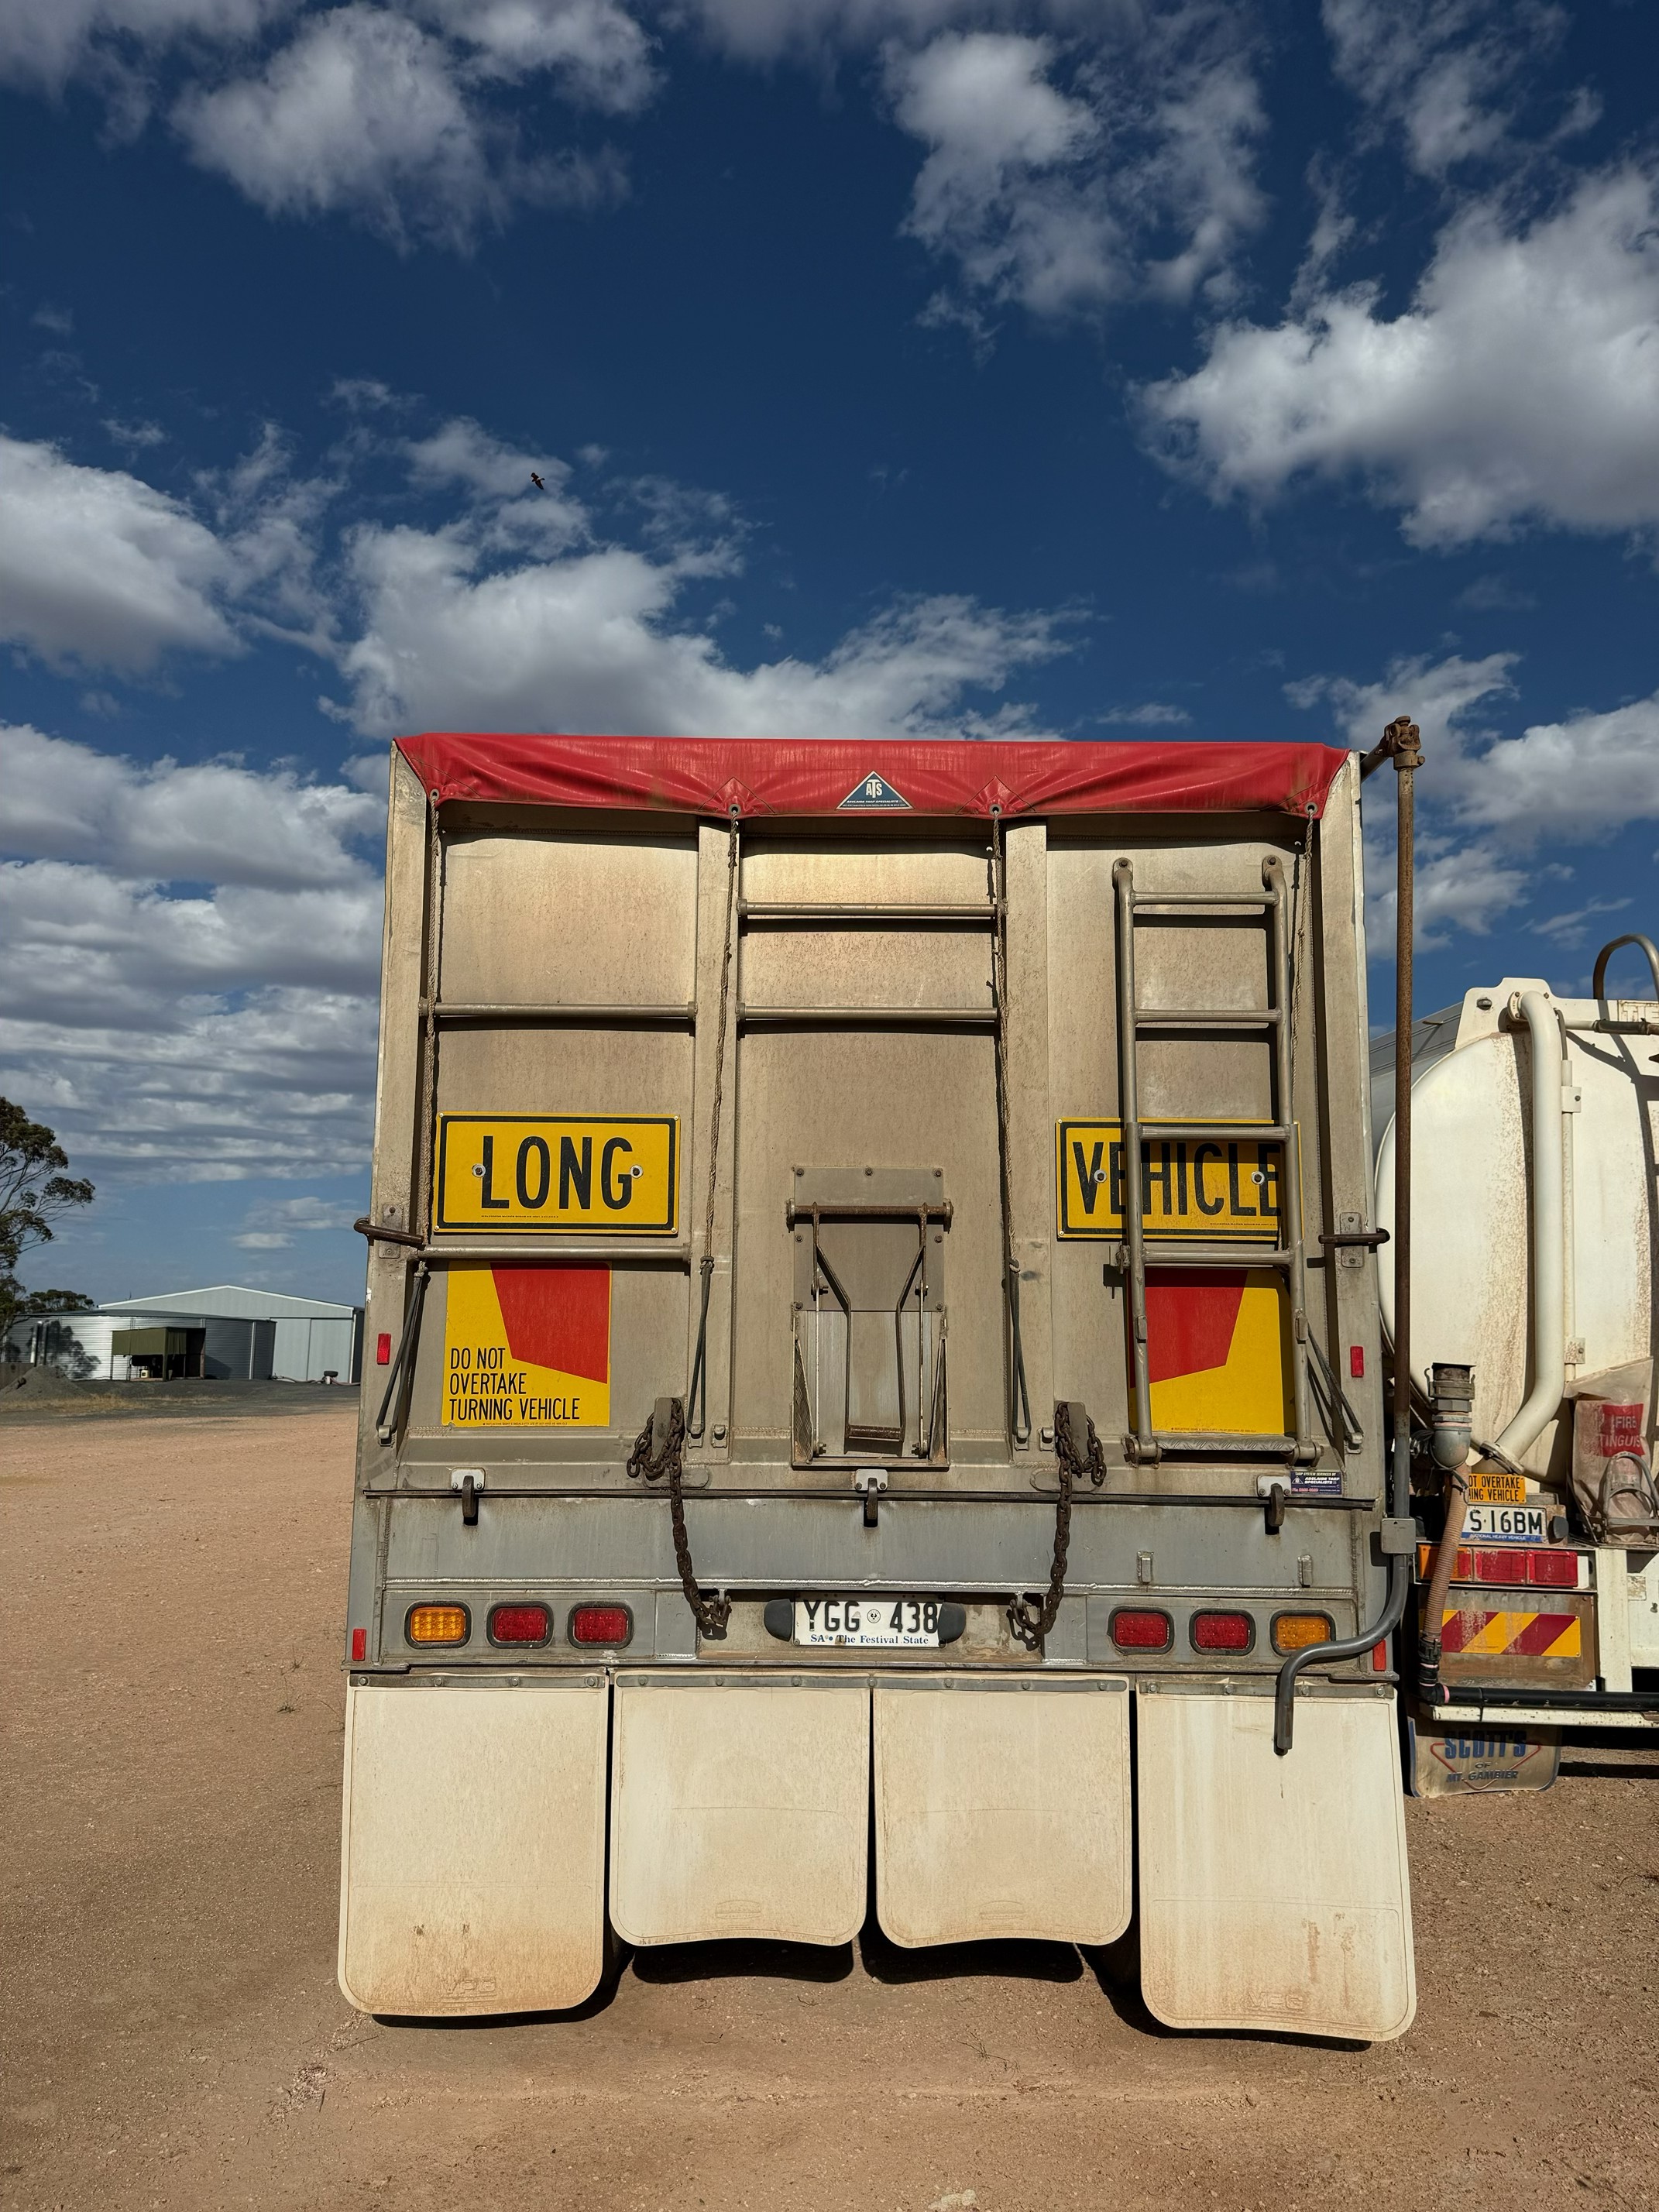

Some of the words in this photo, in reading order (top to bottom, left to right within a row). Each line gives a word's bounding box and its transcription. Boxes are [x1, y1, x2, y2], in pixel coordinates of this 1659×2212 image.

[866, 779, 882, 798] ATS
[481, 1135, 633, 1210] LONG
[1073, 1141, 1282, 1217] VEHICLE
[450, 1348, 471, 1369] DO
[476, 1347, 506, 1369] NOT
[449, 1372, 527, 1395] OVERTAKE
[449, 1397, 513, 1420] TURNING
[519, 1397, 580, 1420] VEHICLE
[1599, 1433, 1641, 1448] TINGUIS
[1468, 1475, 1477, 1488] OT
[1482, 1475, 1520, 1489] OVERTAKE
[1488, 1489, 1519, 1502] VEHICLE
[803, 1599, 860, 1632] YGG
[889, 1600, 938, 1634] 438
[810, 1634, 826, 1643] SA
[836, 1634, 856, 1644] The
[860, 1634, 898, 1644] Festival
[903, 1635, 929, 1644] State
[1444, 1730, 1527, 1759] SCOTT'S
[1468, 1771, 1519, 1781] GAMBIER
